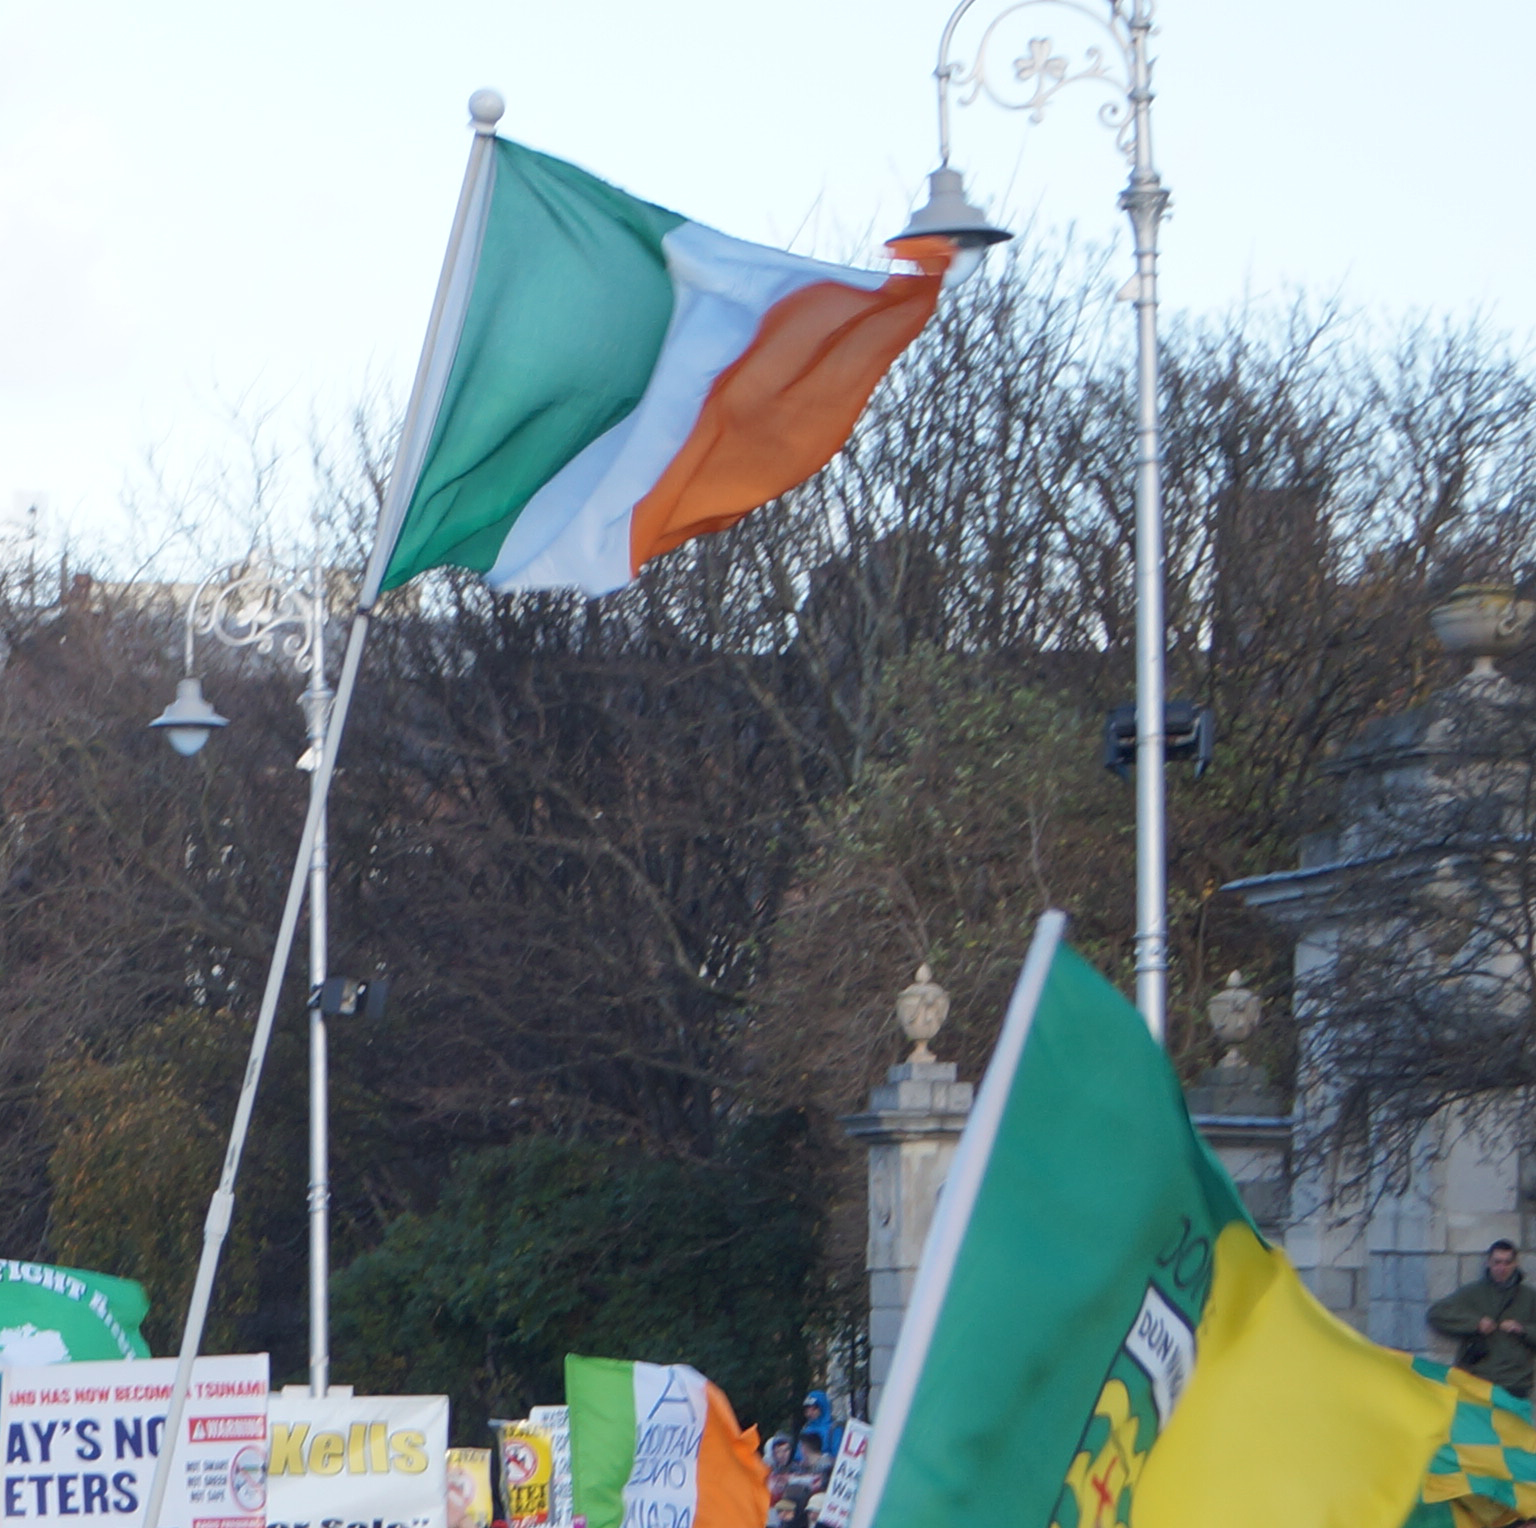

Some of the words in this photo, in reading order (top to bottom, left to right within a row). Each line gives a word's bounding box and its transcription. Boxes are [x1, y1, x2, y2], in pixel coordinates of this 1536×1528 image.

[40, 1387, 70, 1406] HAS
[74, 1386, 111, 1404] NOW
[115, 1383, 176, 1402] BECOM
[196, 1380, 266, 1399] TSUNAMI
[267, 1420, 430, 1476] Kells
[4, 1471, 140, 1518] ETERS
